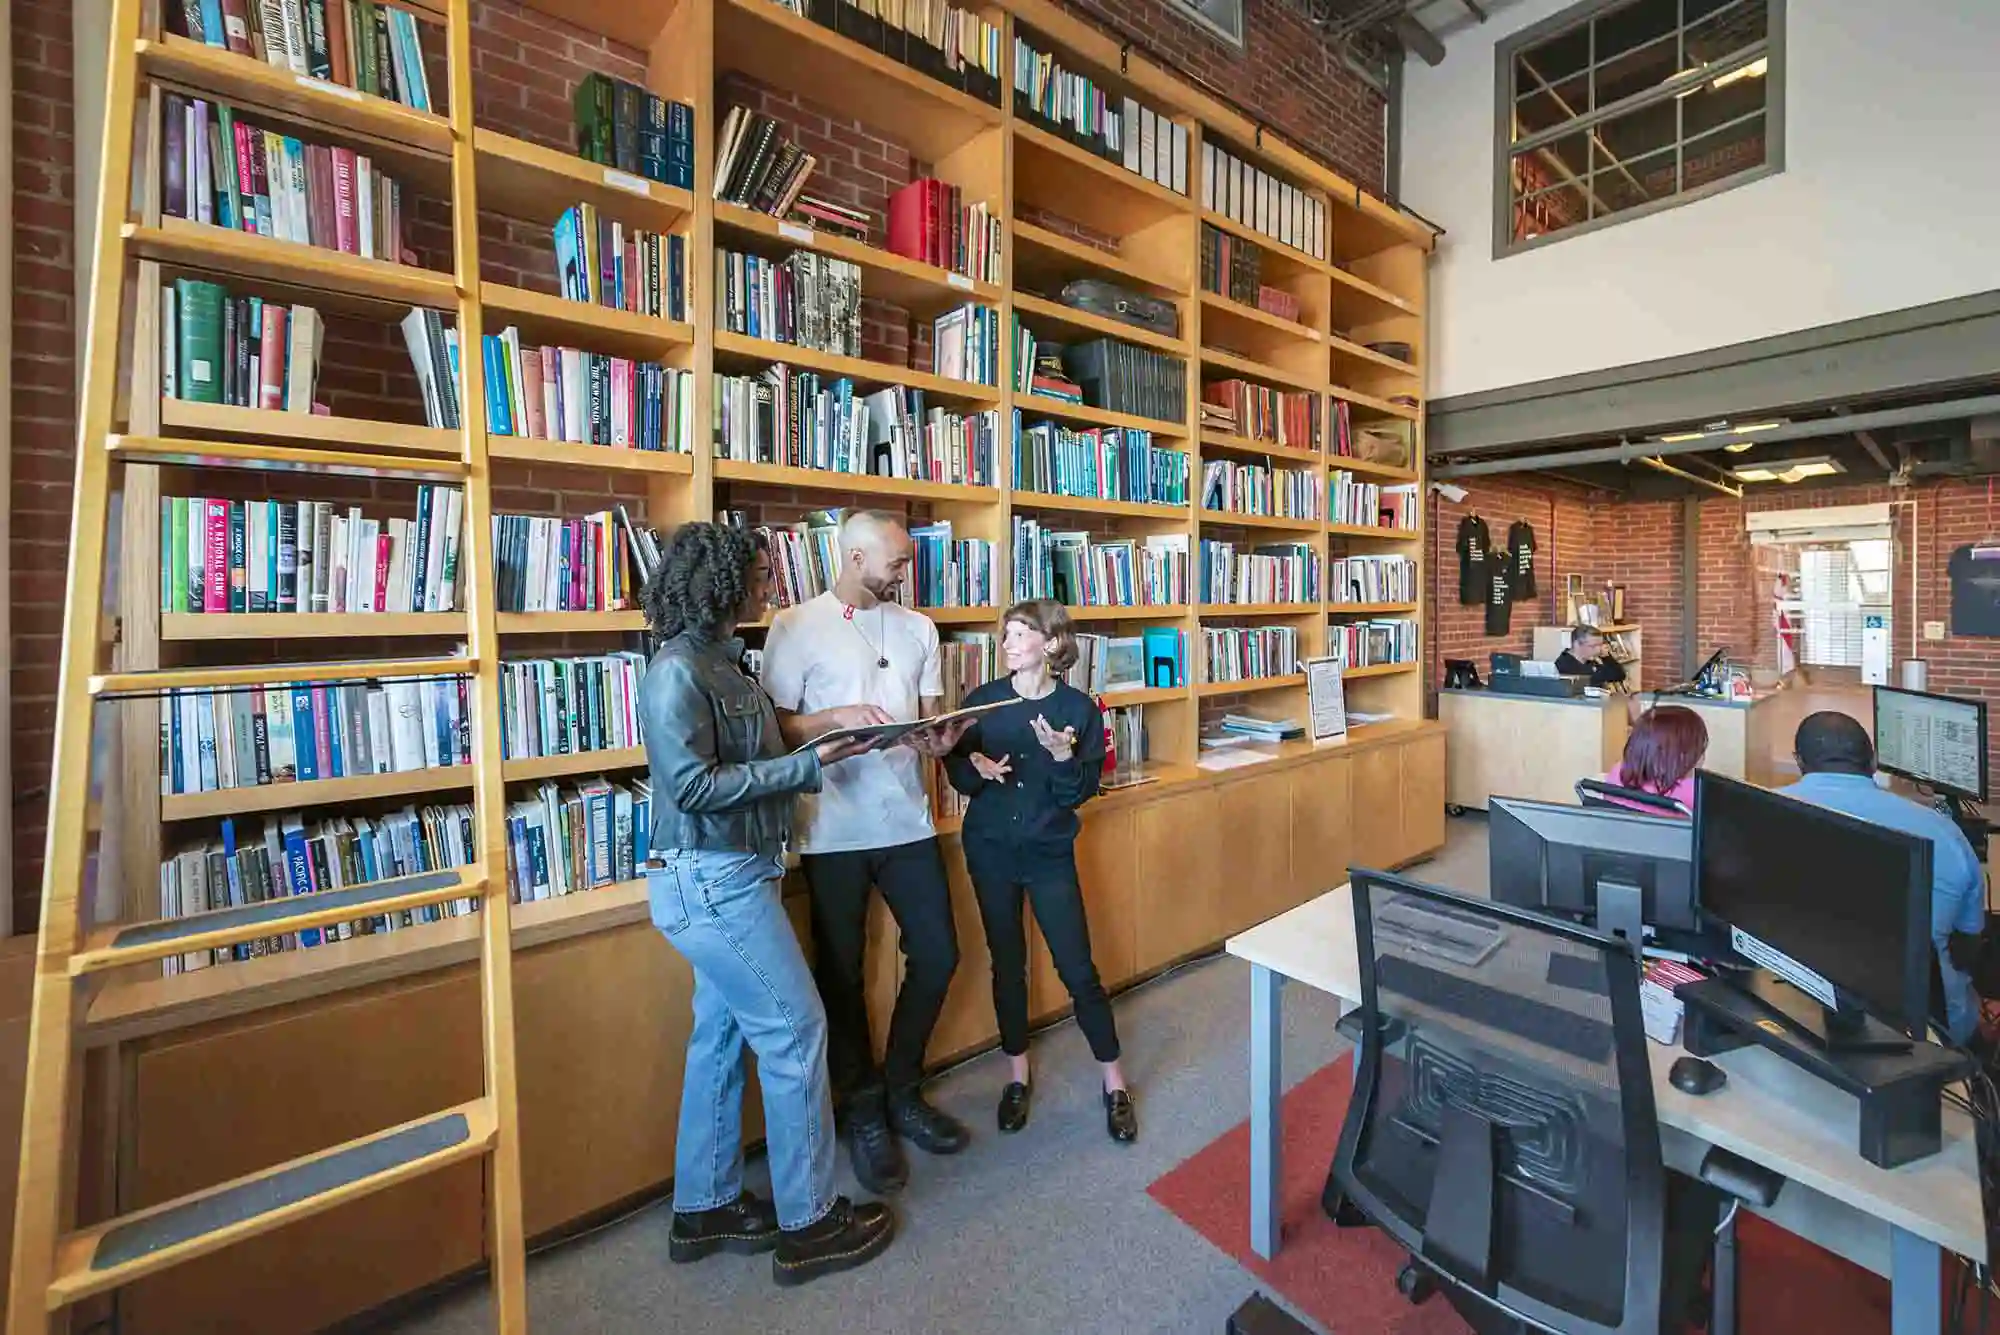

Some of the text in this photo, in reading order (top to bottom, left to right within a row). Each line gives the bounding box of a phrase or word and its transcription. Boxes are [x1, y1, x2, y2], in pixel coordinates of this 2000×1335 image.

[591, 366, 600, 424] THE NEW CANADA
[790, 375, 798, 391] THE
[790, 391, 798, 421] WORLD
[791, 422, 798, 433] AT
[214, 531, 225, 569] NATIONAL
[293, 855, 308, 885] PACIFIC
